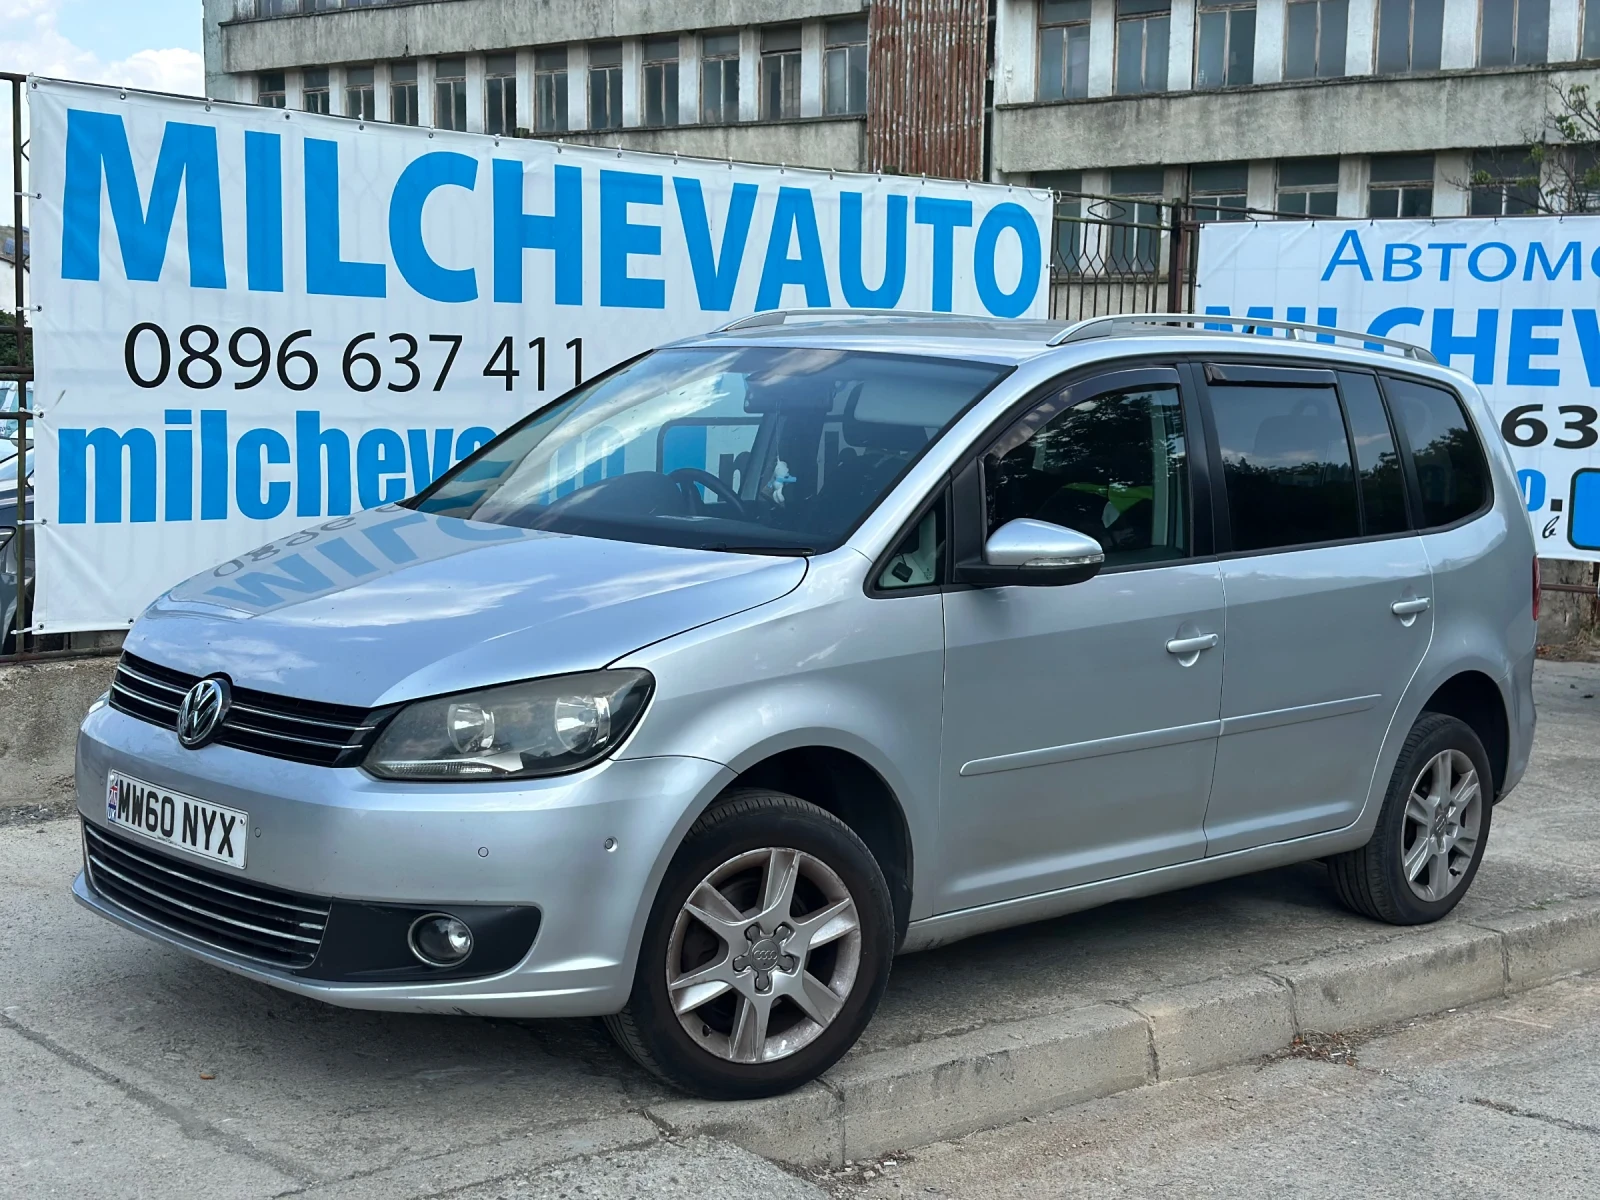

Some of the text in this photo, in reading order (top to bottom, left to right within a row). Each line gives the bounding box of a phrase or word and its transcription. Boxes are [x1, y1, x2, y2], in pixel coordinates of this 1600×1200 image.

[61, 108, 1042, 319] MILCHEVAUTO
[124, 322, 583, 392] 0896 637 411
[118, 779, 236, 858] MW60 NYX
